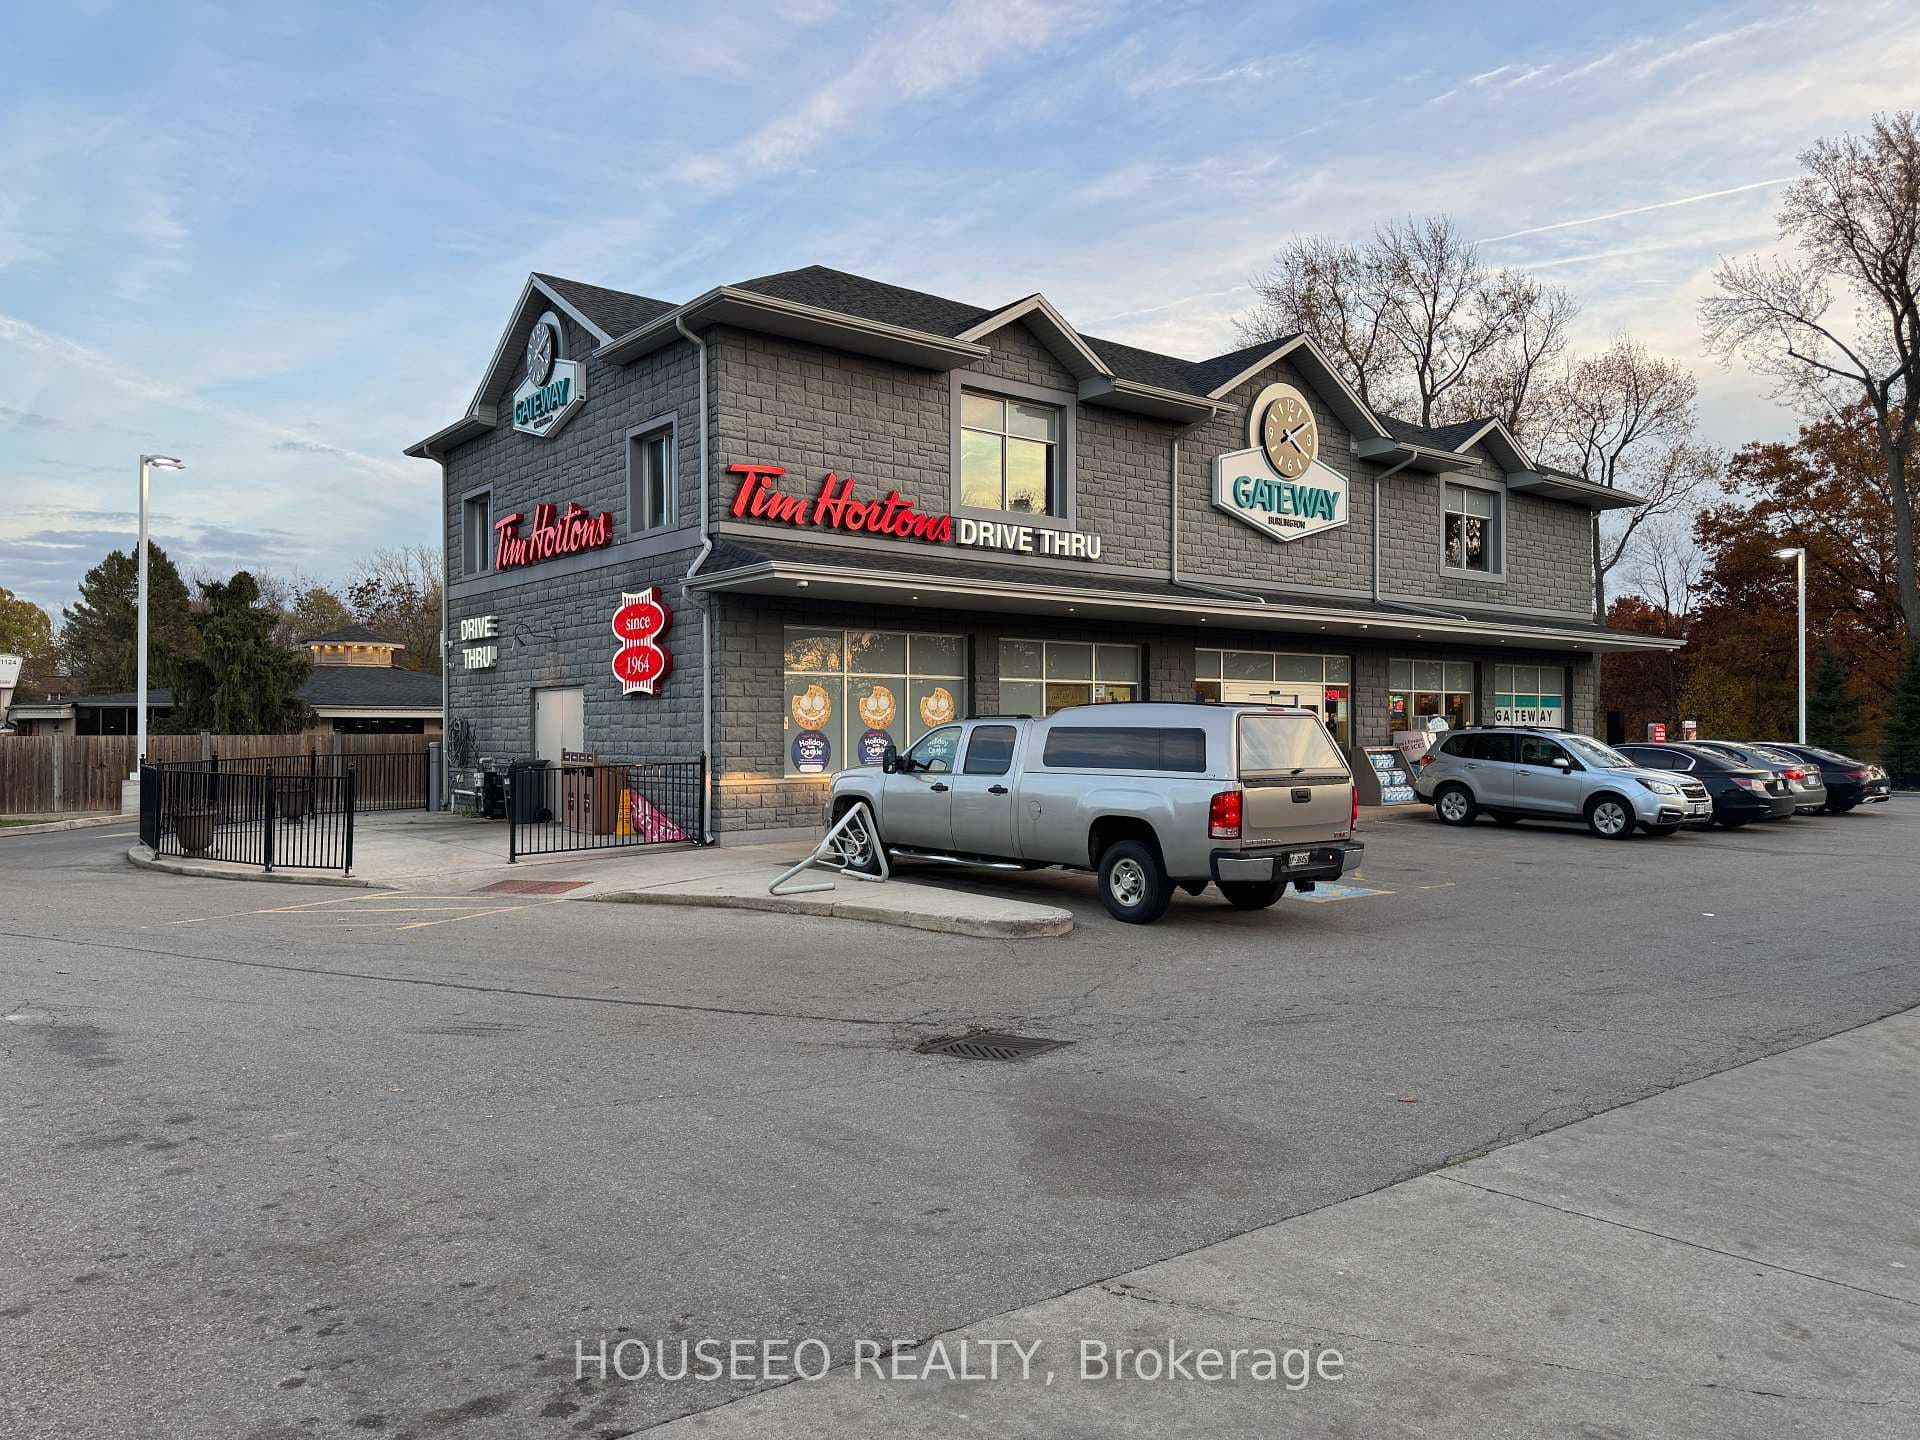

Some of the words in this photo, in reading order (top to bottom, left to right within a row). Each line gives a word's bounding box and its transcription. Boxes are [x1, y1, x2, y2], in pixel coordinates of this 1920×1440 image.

[515, 377, 571, 426] GATEWAY
[1286, 399, 1295, 413] 12
[1268, 426, 1274, 439] 9
[1306, 434, 1312, 447] 3
[1287, 458, 1293, 472] 6
[727, 463, 808, 527] Tim
[811, 471, 951, 543] Hortons
[1232, 475, 1341, 522] GATEWAY
[495, 513, 528, 572] Tim
[529, 502, 613, 561] Hortons
[956, 518, 1033, 552] DRIVE
[1035, 528, 1101, 560] THRU
[460, 615, 499, 641] DRIVE
[625, 612, 651, 632] since
[462, 645, 498, 670] THRU
[626, 652, 650, 676] 1964
[1495, 709, 1552, 722] GATEWAY
